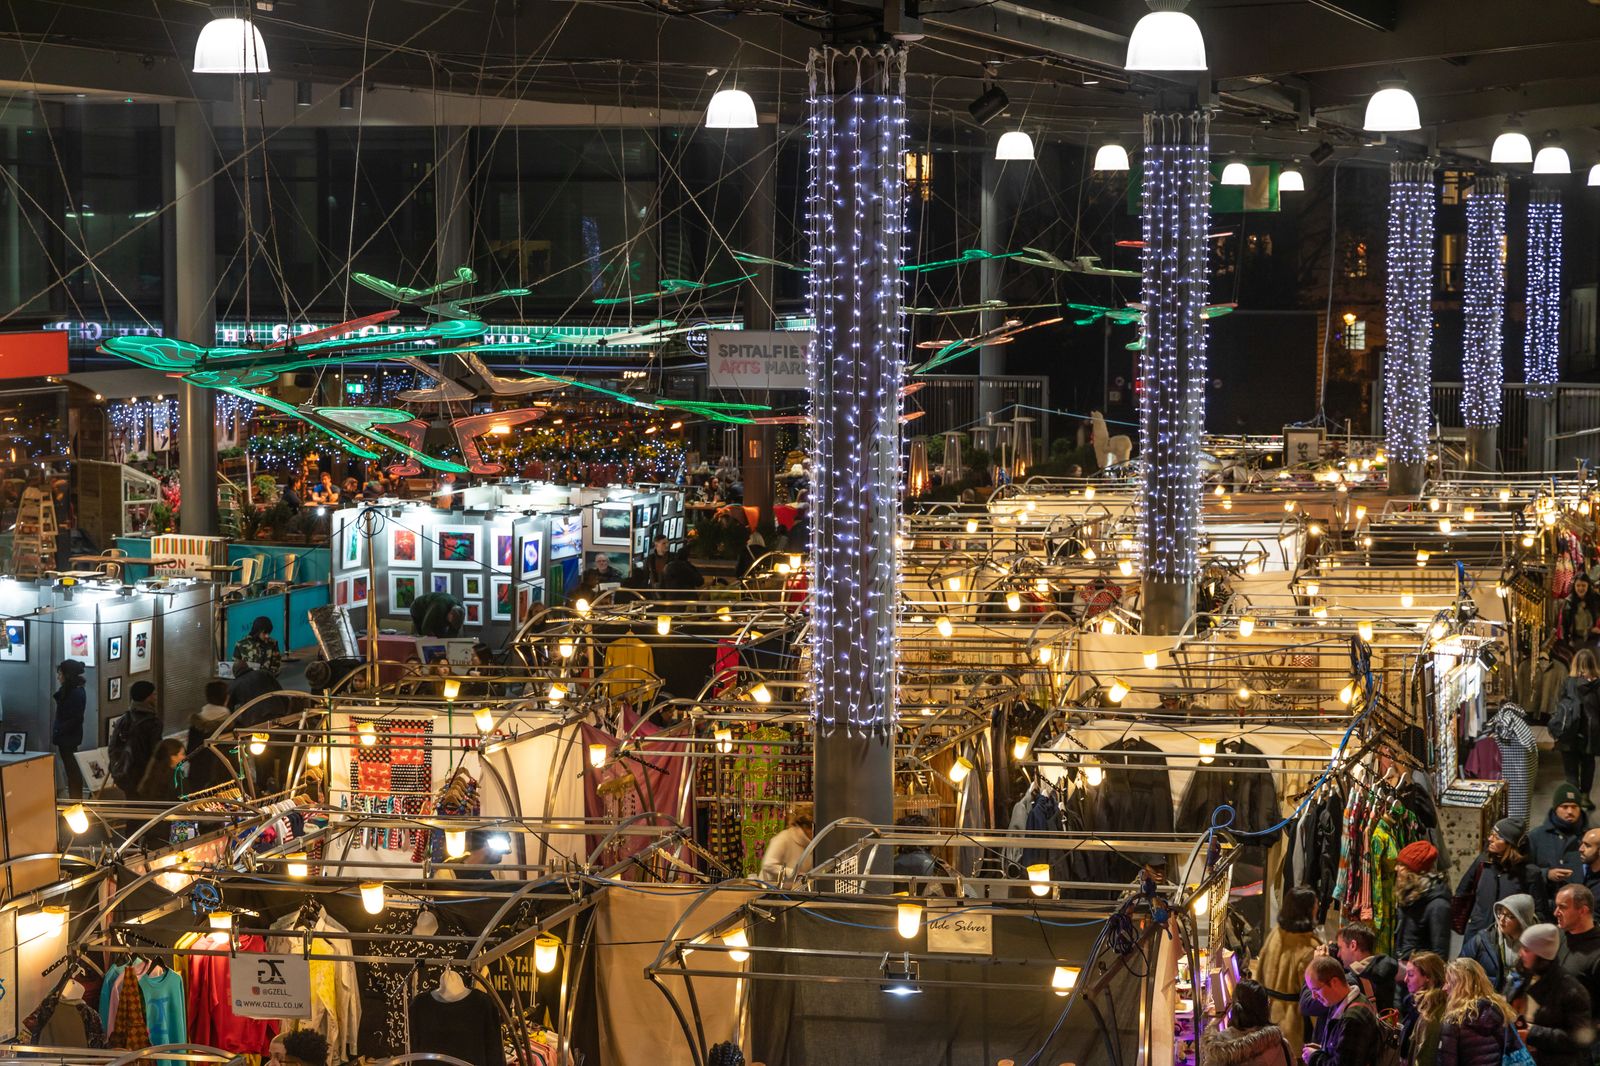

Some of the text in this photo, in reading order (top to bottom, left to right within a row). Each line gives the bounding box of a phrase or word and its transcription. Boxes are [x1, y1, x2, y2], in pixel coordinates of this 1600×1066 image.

[719, 361, 760, 375] ARTS
[1411, 570, 1485, 595] HUYK
[954, 920, 988, 932] Silver
[243, 1000, 304, 1009] WWW.GZELL.CO.UK
